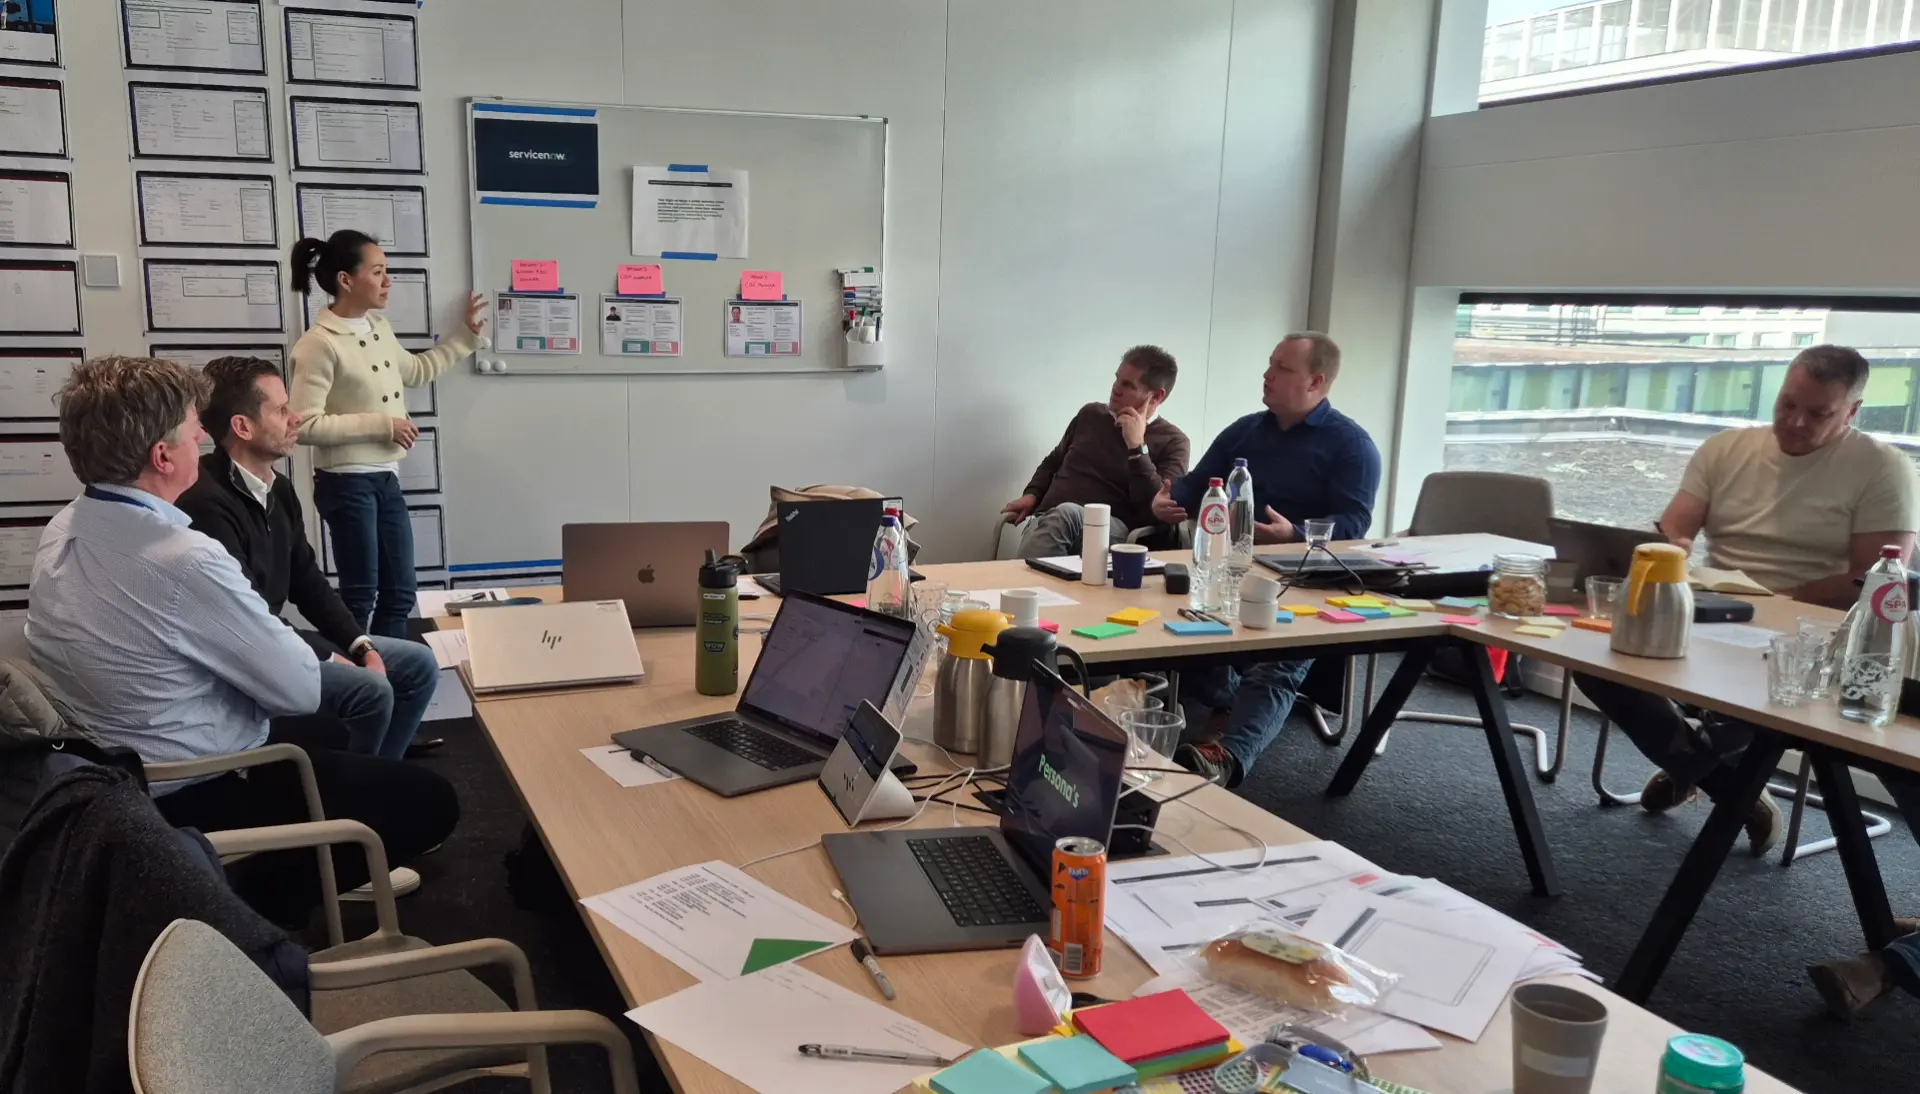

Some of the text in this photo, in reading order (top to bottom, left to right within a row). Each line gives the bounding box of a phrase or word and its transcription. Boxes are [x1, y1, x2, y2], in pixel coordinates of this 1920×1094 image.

[508, 149, 566, 160] servicenow
[1885, 600, 1907, 609] SPA
[541, 629, 562, 650] hp
[1038, 753, 1080, 809] Persona's
